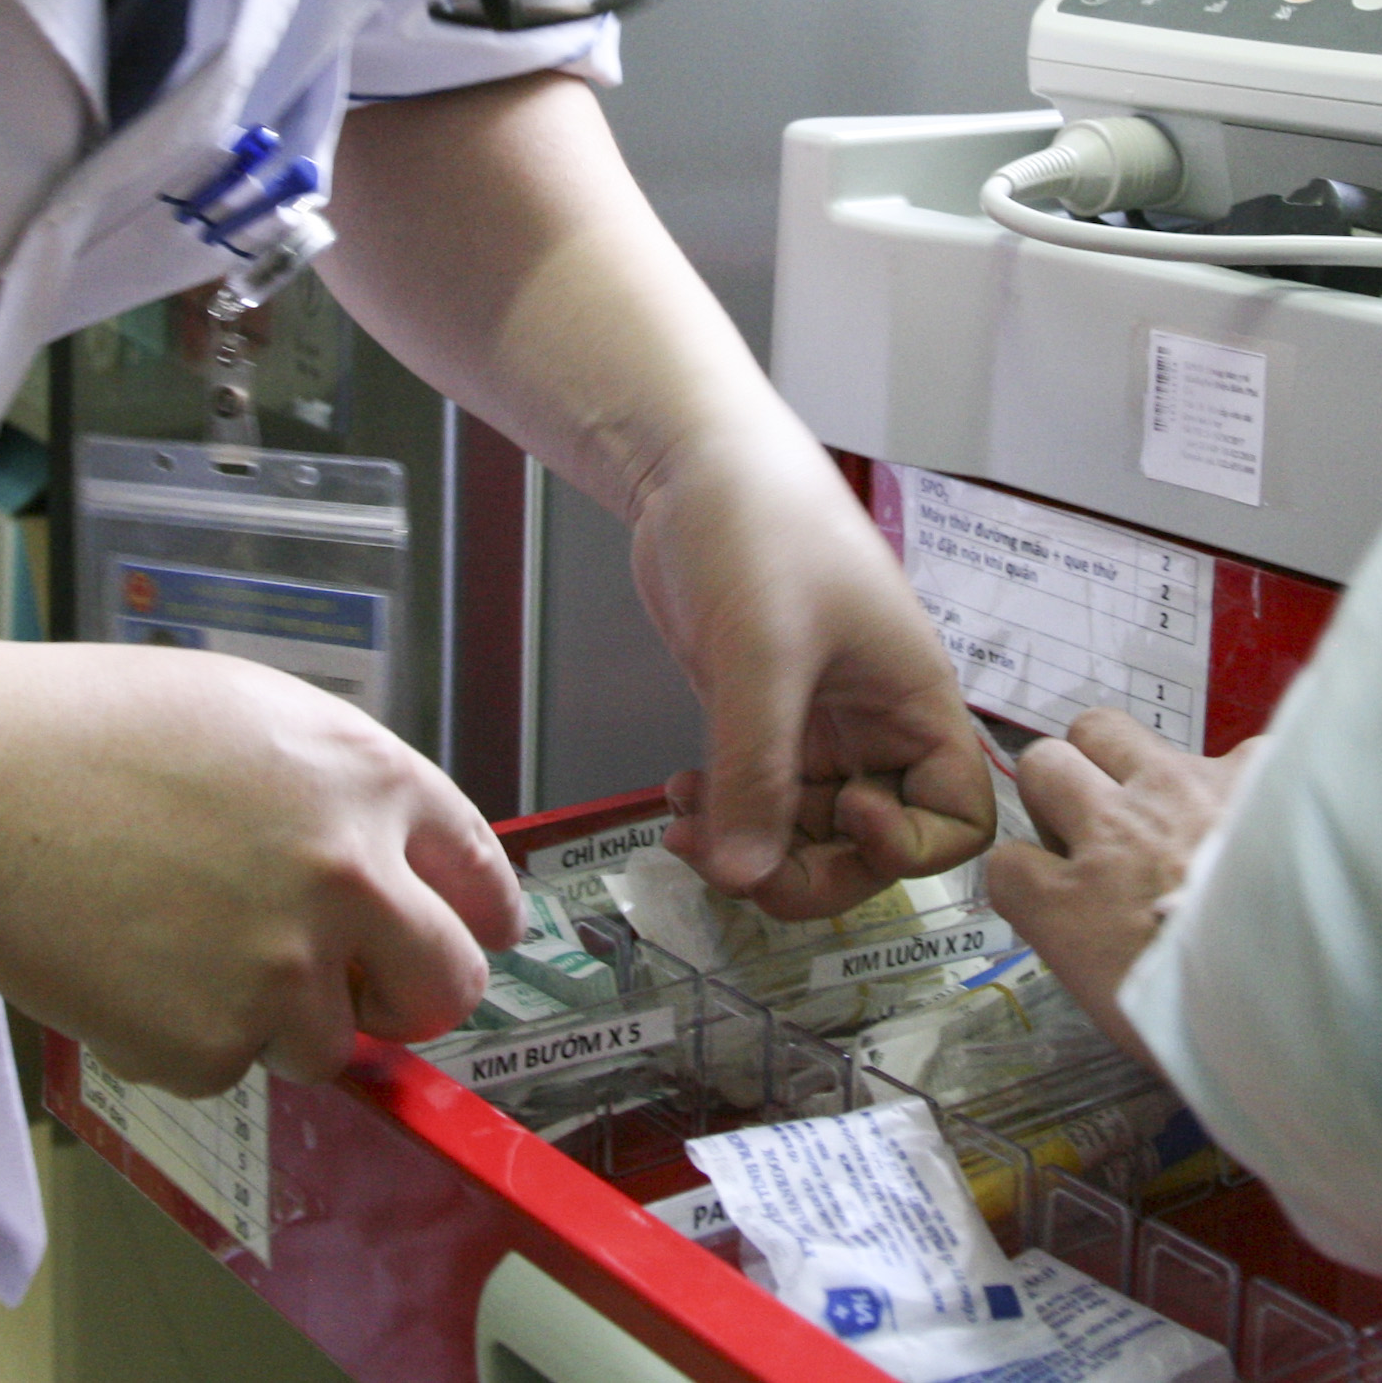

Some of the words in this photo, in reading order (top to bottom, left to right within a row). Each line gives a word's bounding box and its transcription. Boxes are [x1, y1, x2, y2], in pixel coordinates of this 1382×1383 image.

[1064, 554, 1090, 574] que
[1162, 554, 1171, 572] 2
[1161, 583, 1170, 601] 2
[1159, 612, 1169, 629] 2
[1156, 683, 1165, 701] 1
[1153, 712, 1162, 729] 1
[561, 836, 595, 868] CHỈ
[600, 824, 656, 859] KHÂU
[842, 950, 880, 977] KIM
[886, 935, 939, 968] LUỒN
[945, 935, 957, 956] X
[961, 930, 985, 951] 20
[472, 1052, 517, 1082] KIM
[525, 1031, 601, 1069] BƯỚM
[608, 1027, 622, 1048] X
[628, 1022, 641, 1044] 5
